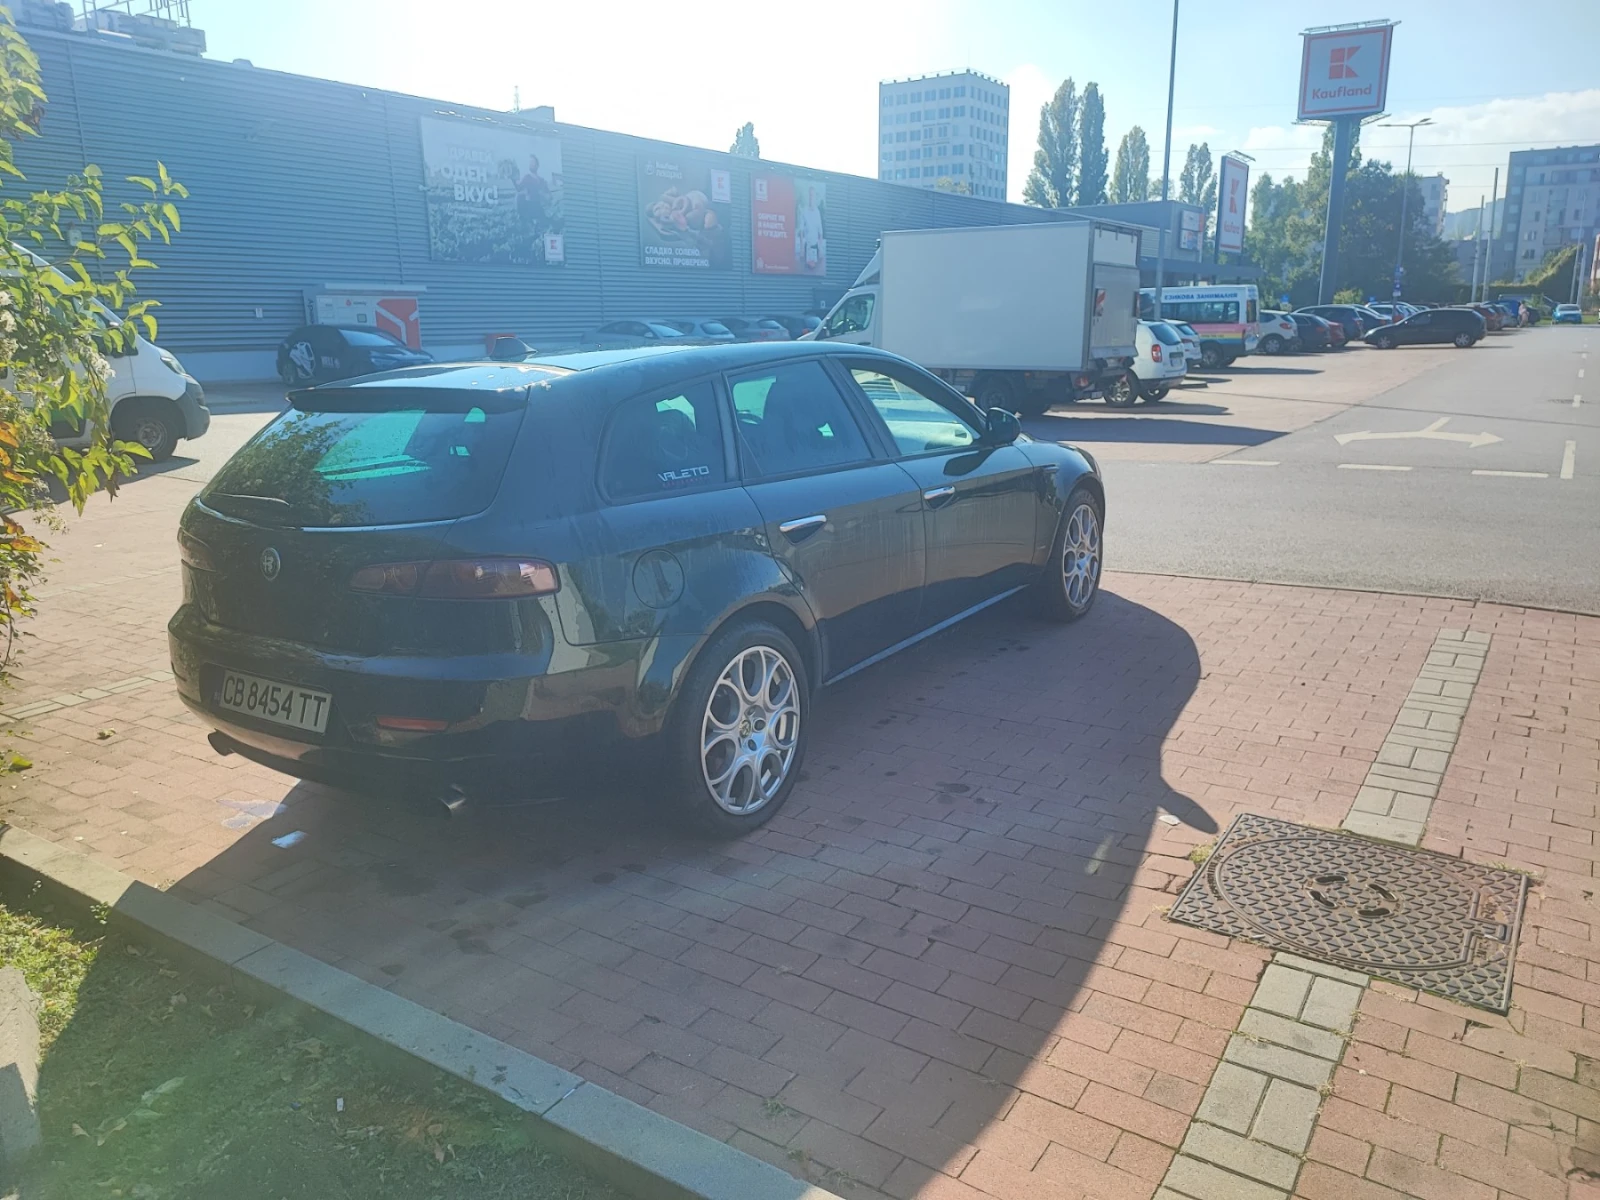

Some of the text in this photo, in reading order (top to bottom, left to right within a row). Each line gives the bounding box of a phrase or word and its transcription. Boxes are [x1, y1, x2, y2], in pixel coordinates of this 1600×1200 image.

[1312, 83, 1372, 100] Kaufland
[429, 162, 487, 184] РОДЕН
[453, 184, 499, 204] ВКУС!
[657, 466, 709, 481] VALETO
[223, 675, 327, 727] CB 8454 TT
